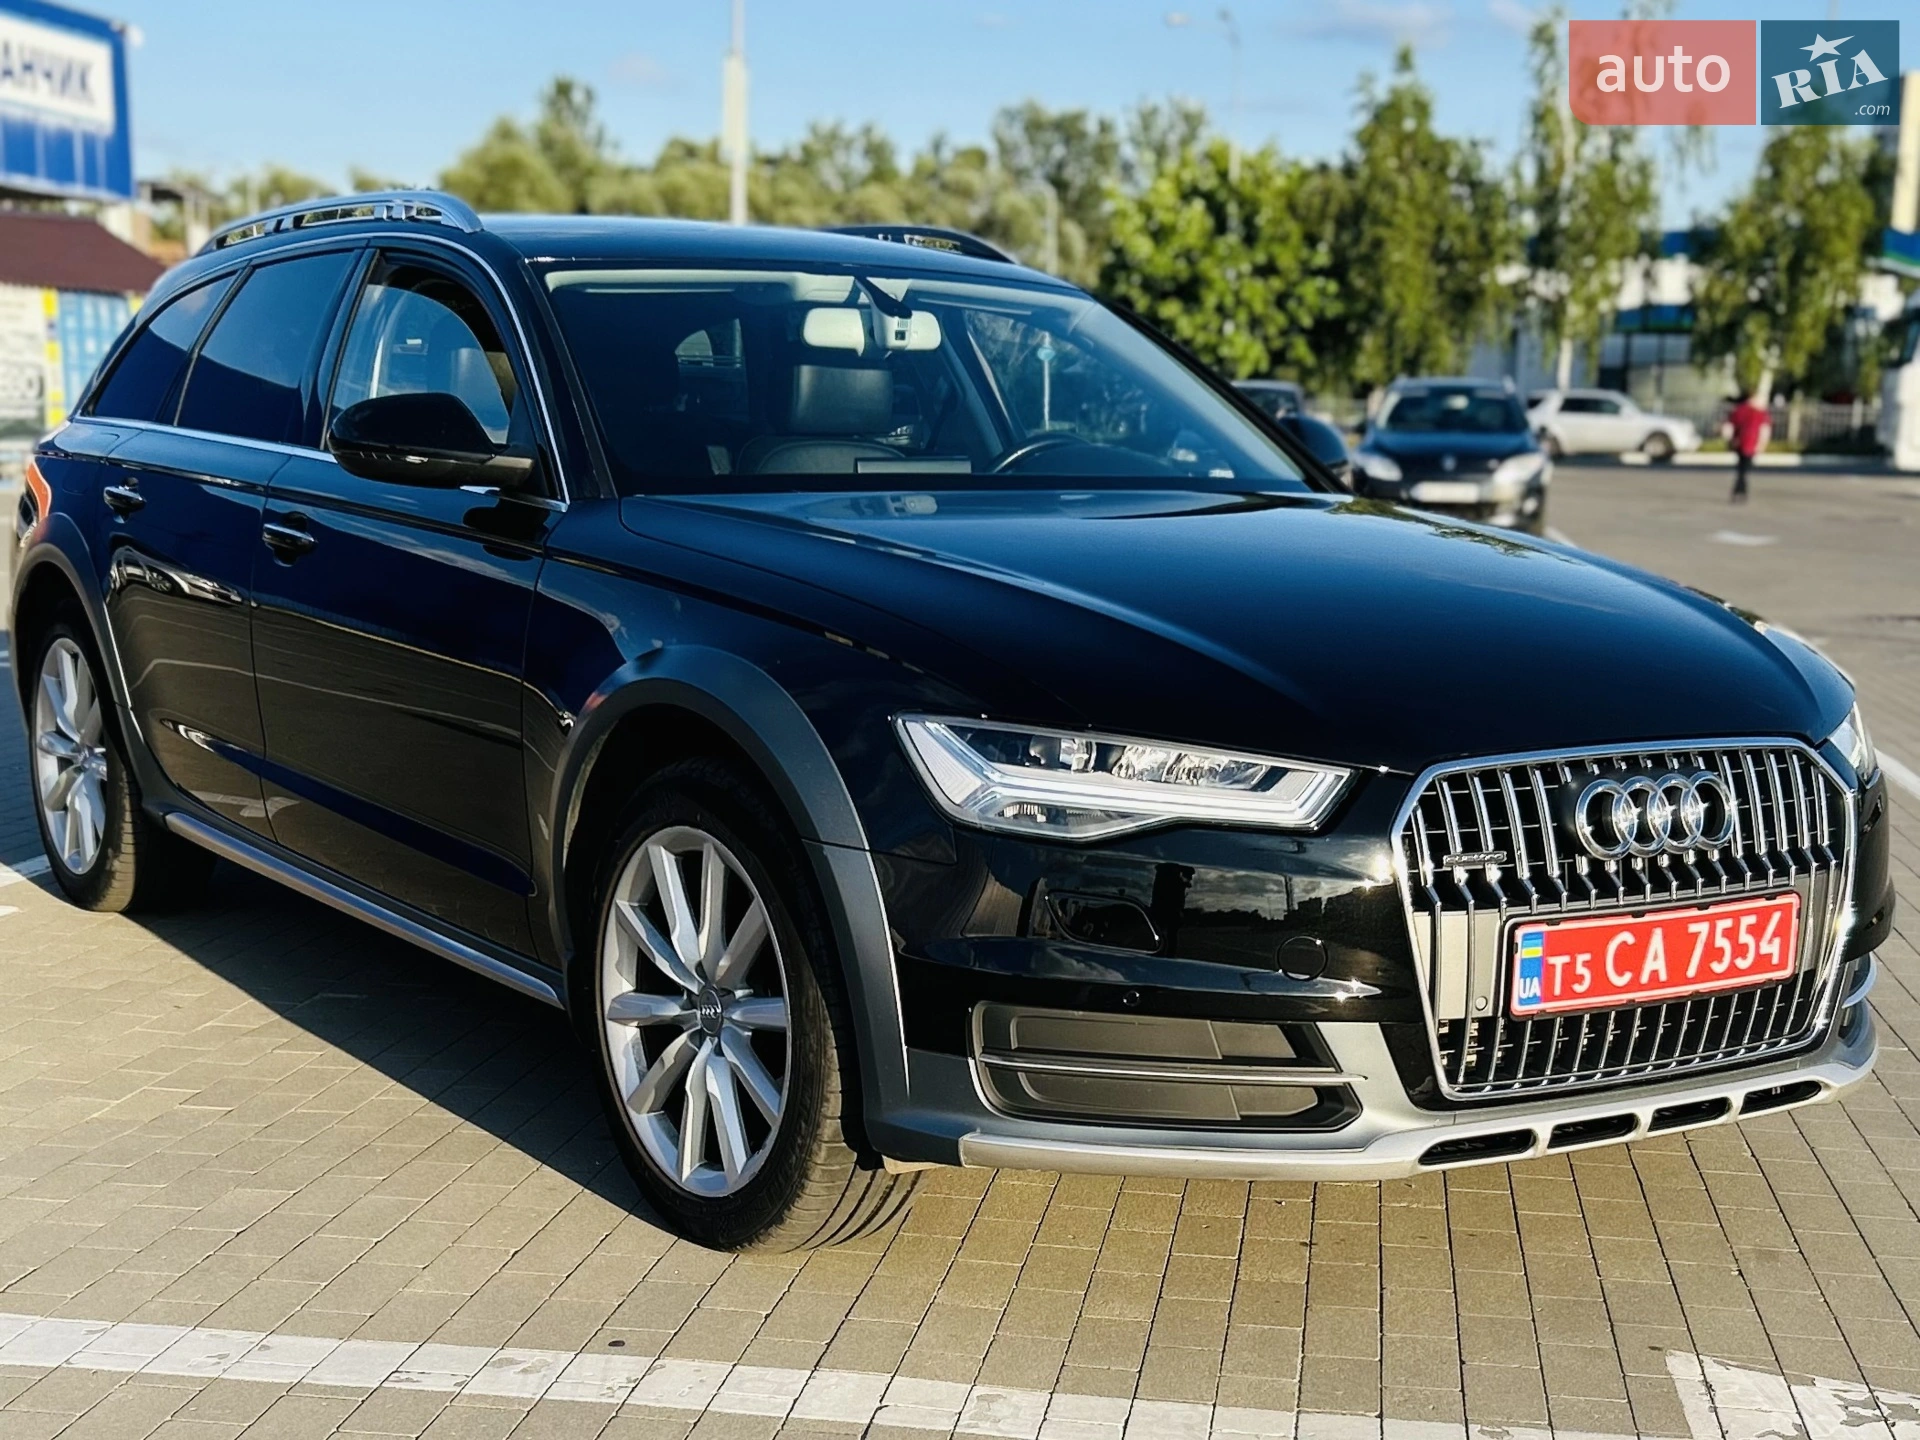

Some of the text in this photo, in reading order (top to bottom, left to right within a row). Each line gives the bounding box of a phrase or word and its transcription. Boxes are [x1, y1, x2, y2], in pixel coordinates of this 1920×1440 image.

[1546, 911, 1782, 996] T5 CA 7554
[1519, 976, 1541, 999] UA
